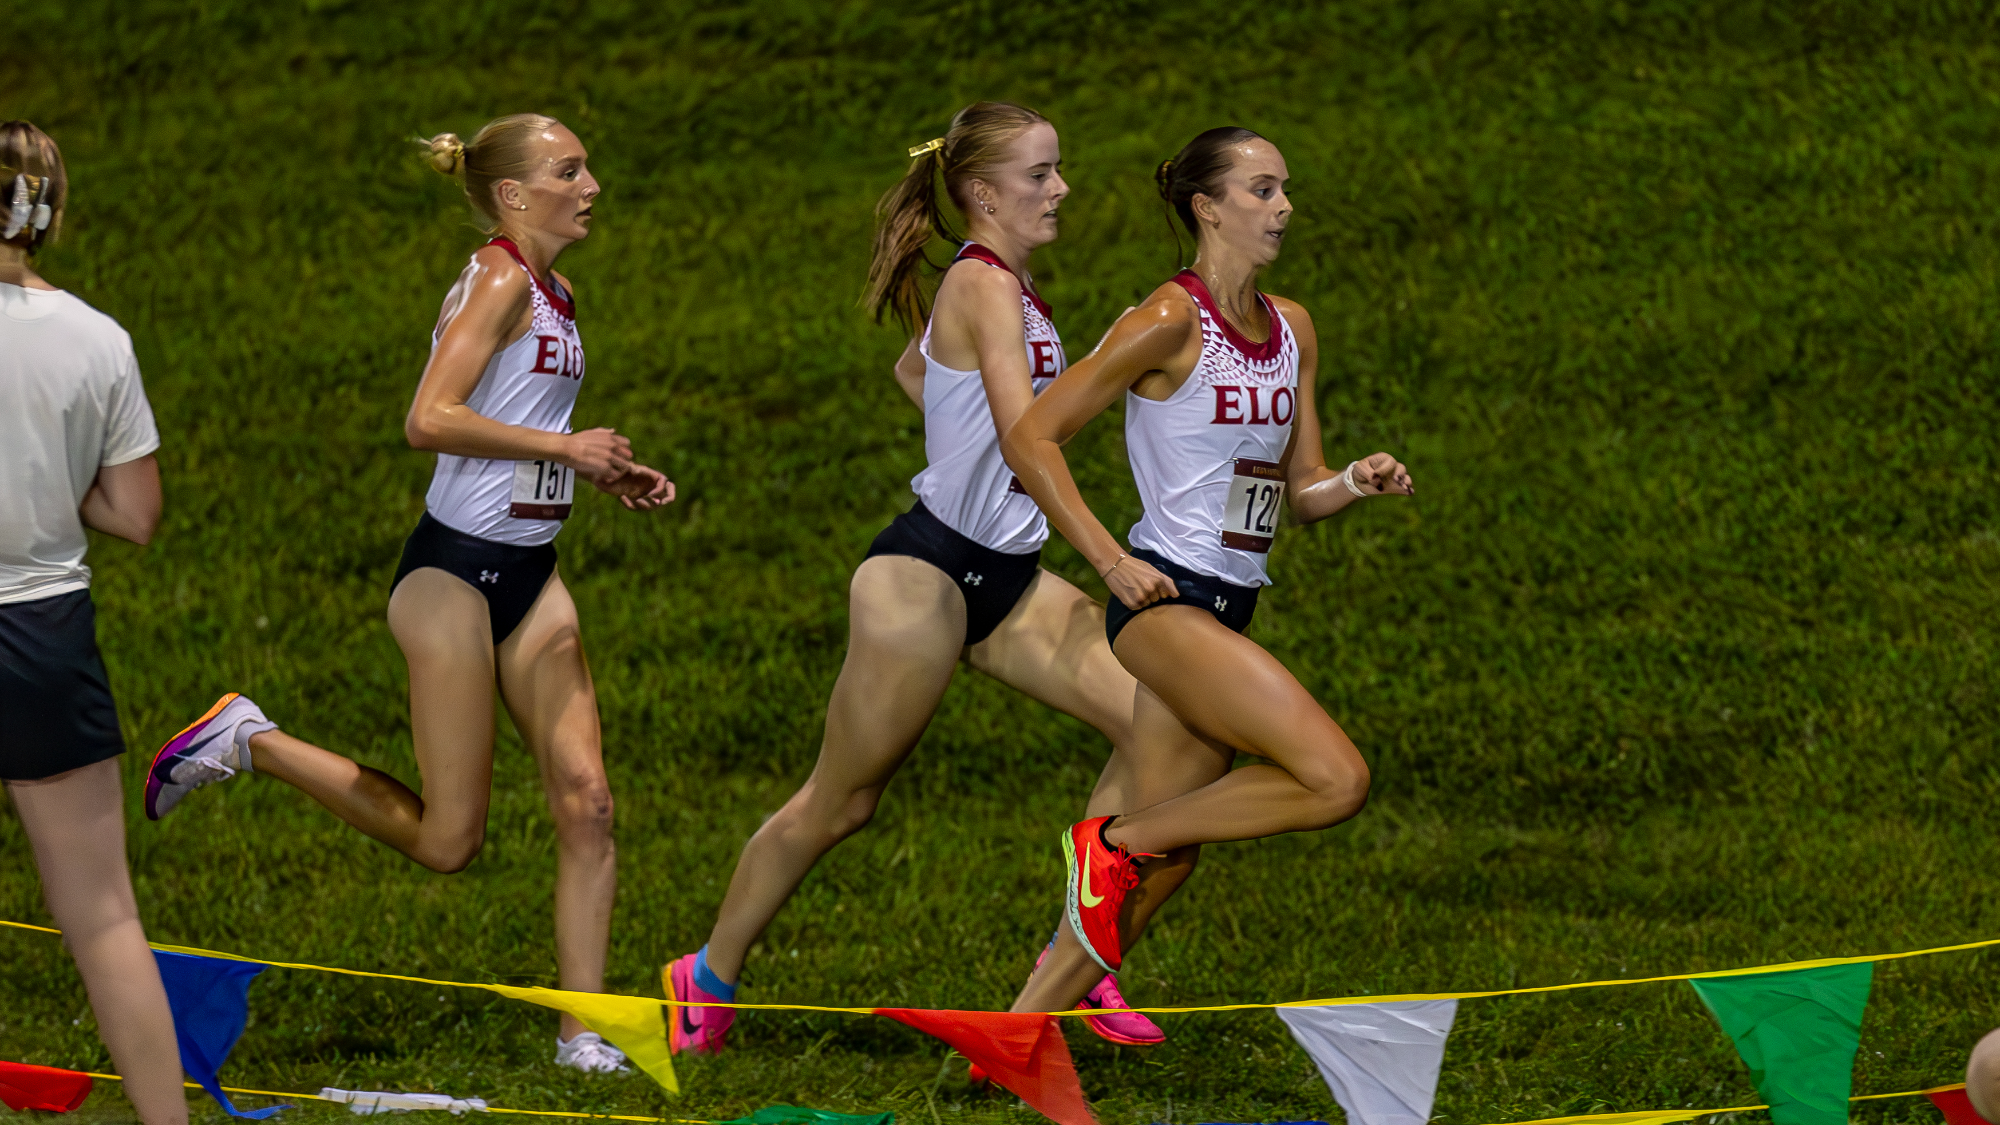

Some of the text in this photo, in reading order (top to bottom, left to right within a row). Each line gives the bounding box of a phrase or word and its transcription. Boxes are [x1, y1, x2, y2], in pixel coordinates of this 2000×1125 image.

[1209, 385, 1297, 426] ELO
[534, 460, 567, 500] 151
[1244, 483, 1281, 533] 122
